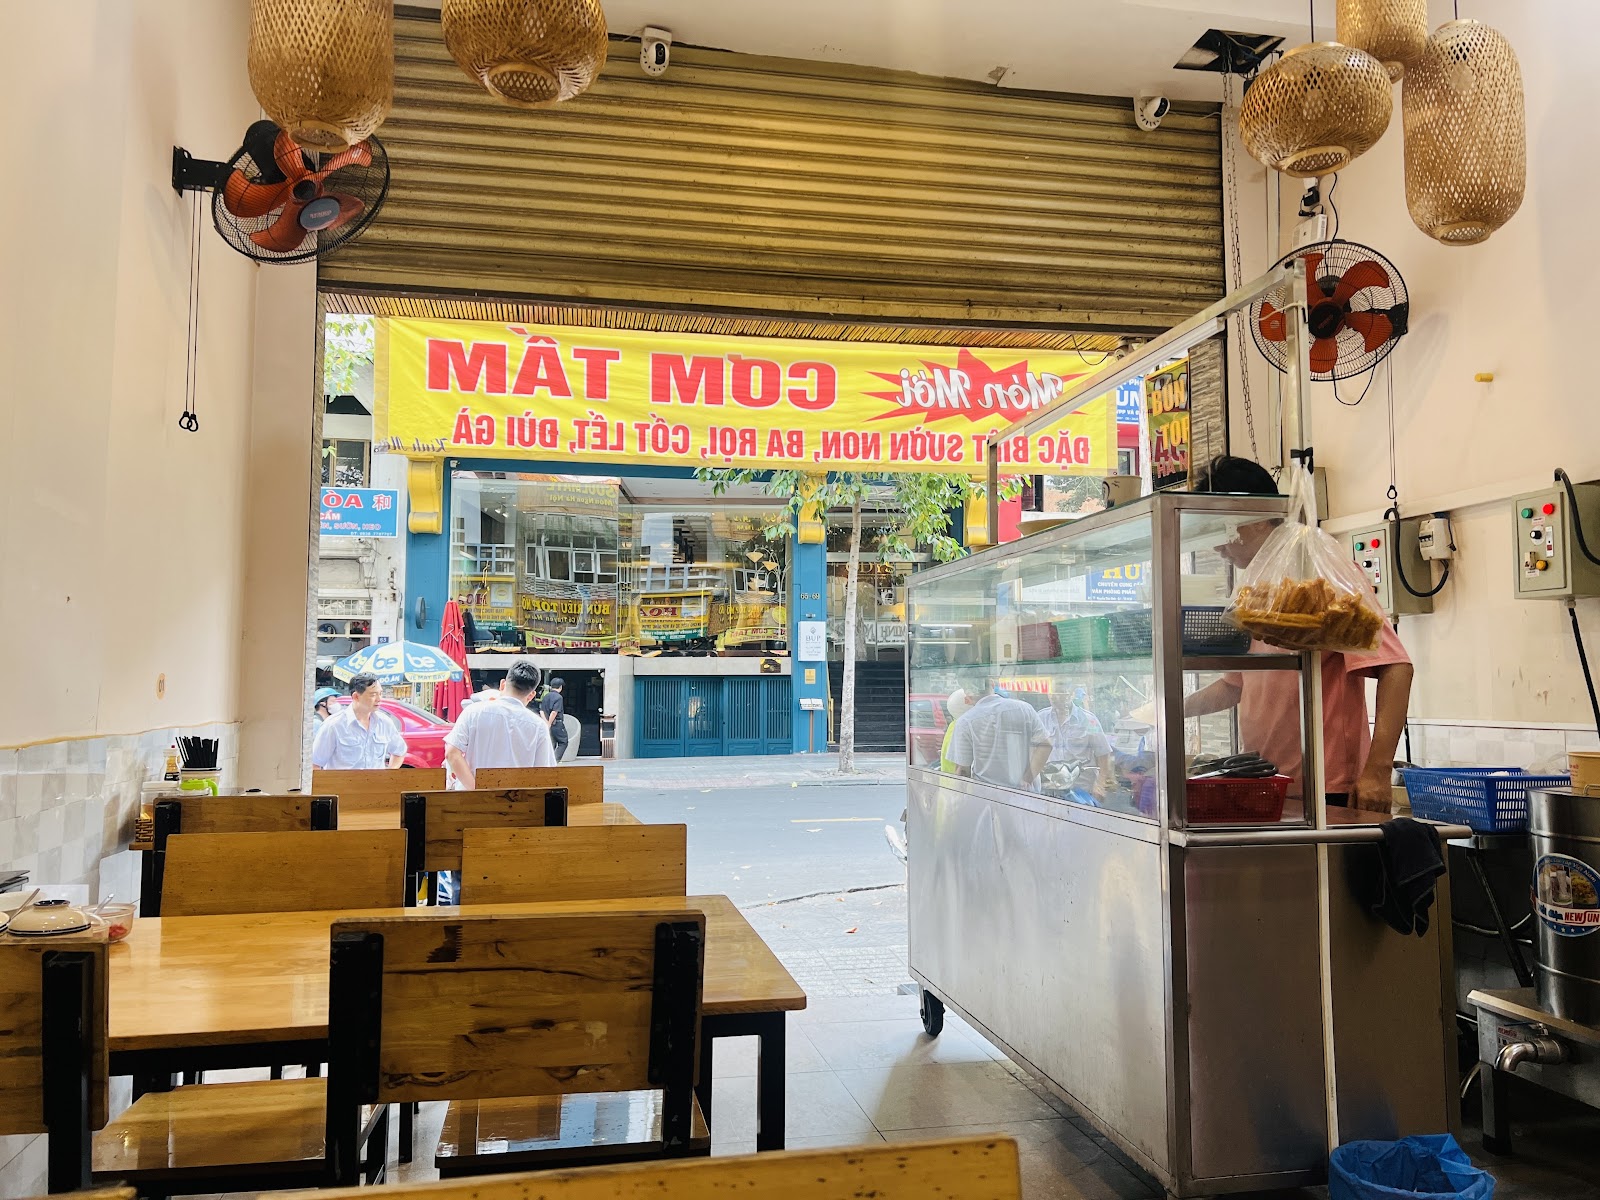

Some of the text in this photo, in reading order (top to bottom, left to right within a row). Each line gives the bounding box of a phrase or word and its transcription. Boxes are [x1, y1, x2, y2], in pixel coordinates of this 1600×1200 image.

[372, 494, 392, 511] 和
[373, 654, 398, 670] be
[406, 653, 436, 668] be
